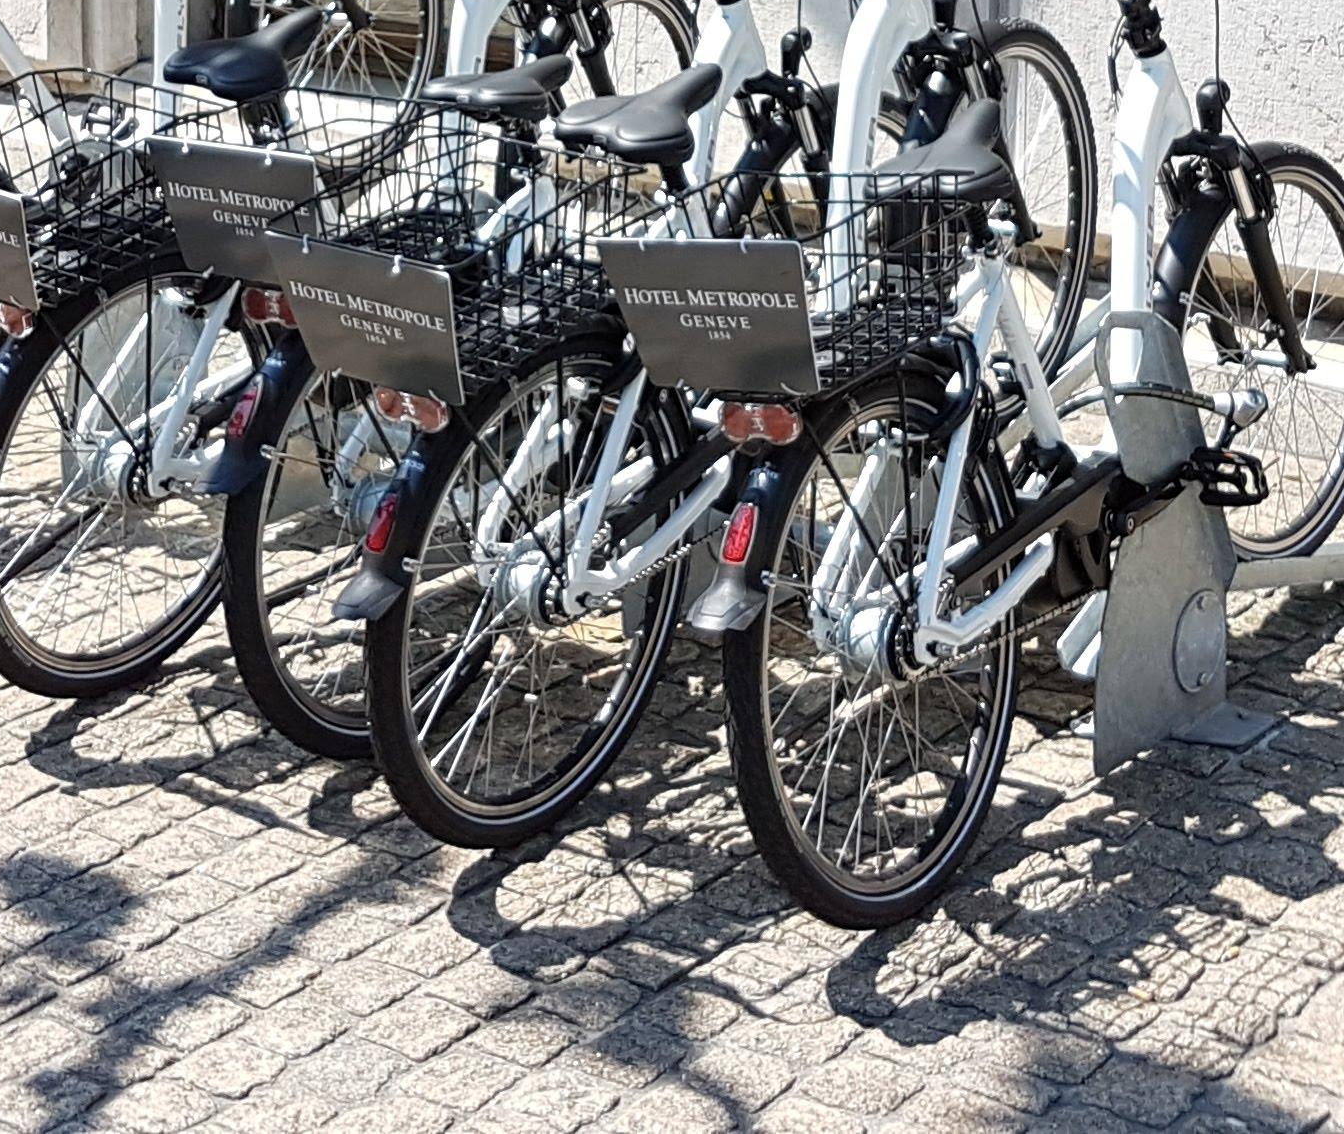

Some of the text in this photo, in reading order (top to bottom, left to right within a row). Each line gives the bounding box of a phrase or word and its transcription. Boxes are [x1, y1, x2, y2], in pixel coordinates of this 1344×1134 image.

[168, 182, 219, 203] HOTEL
[289, 280, 447, 332] HOTEL METROPOLE
[624, 288, 799, 308] HOTEL METROPOLE
[340, 314, 404, 340] GENEVE
[680, 313, 752, 329] GENEVE
